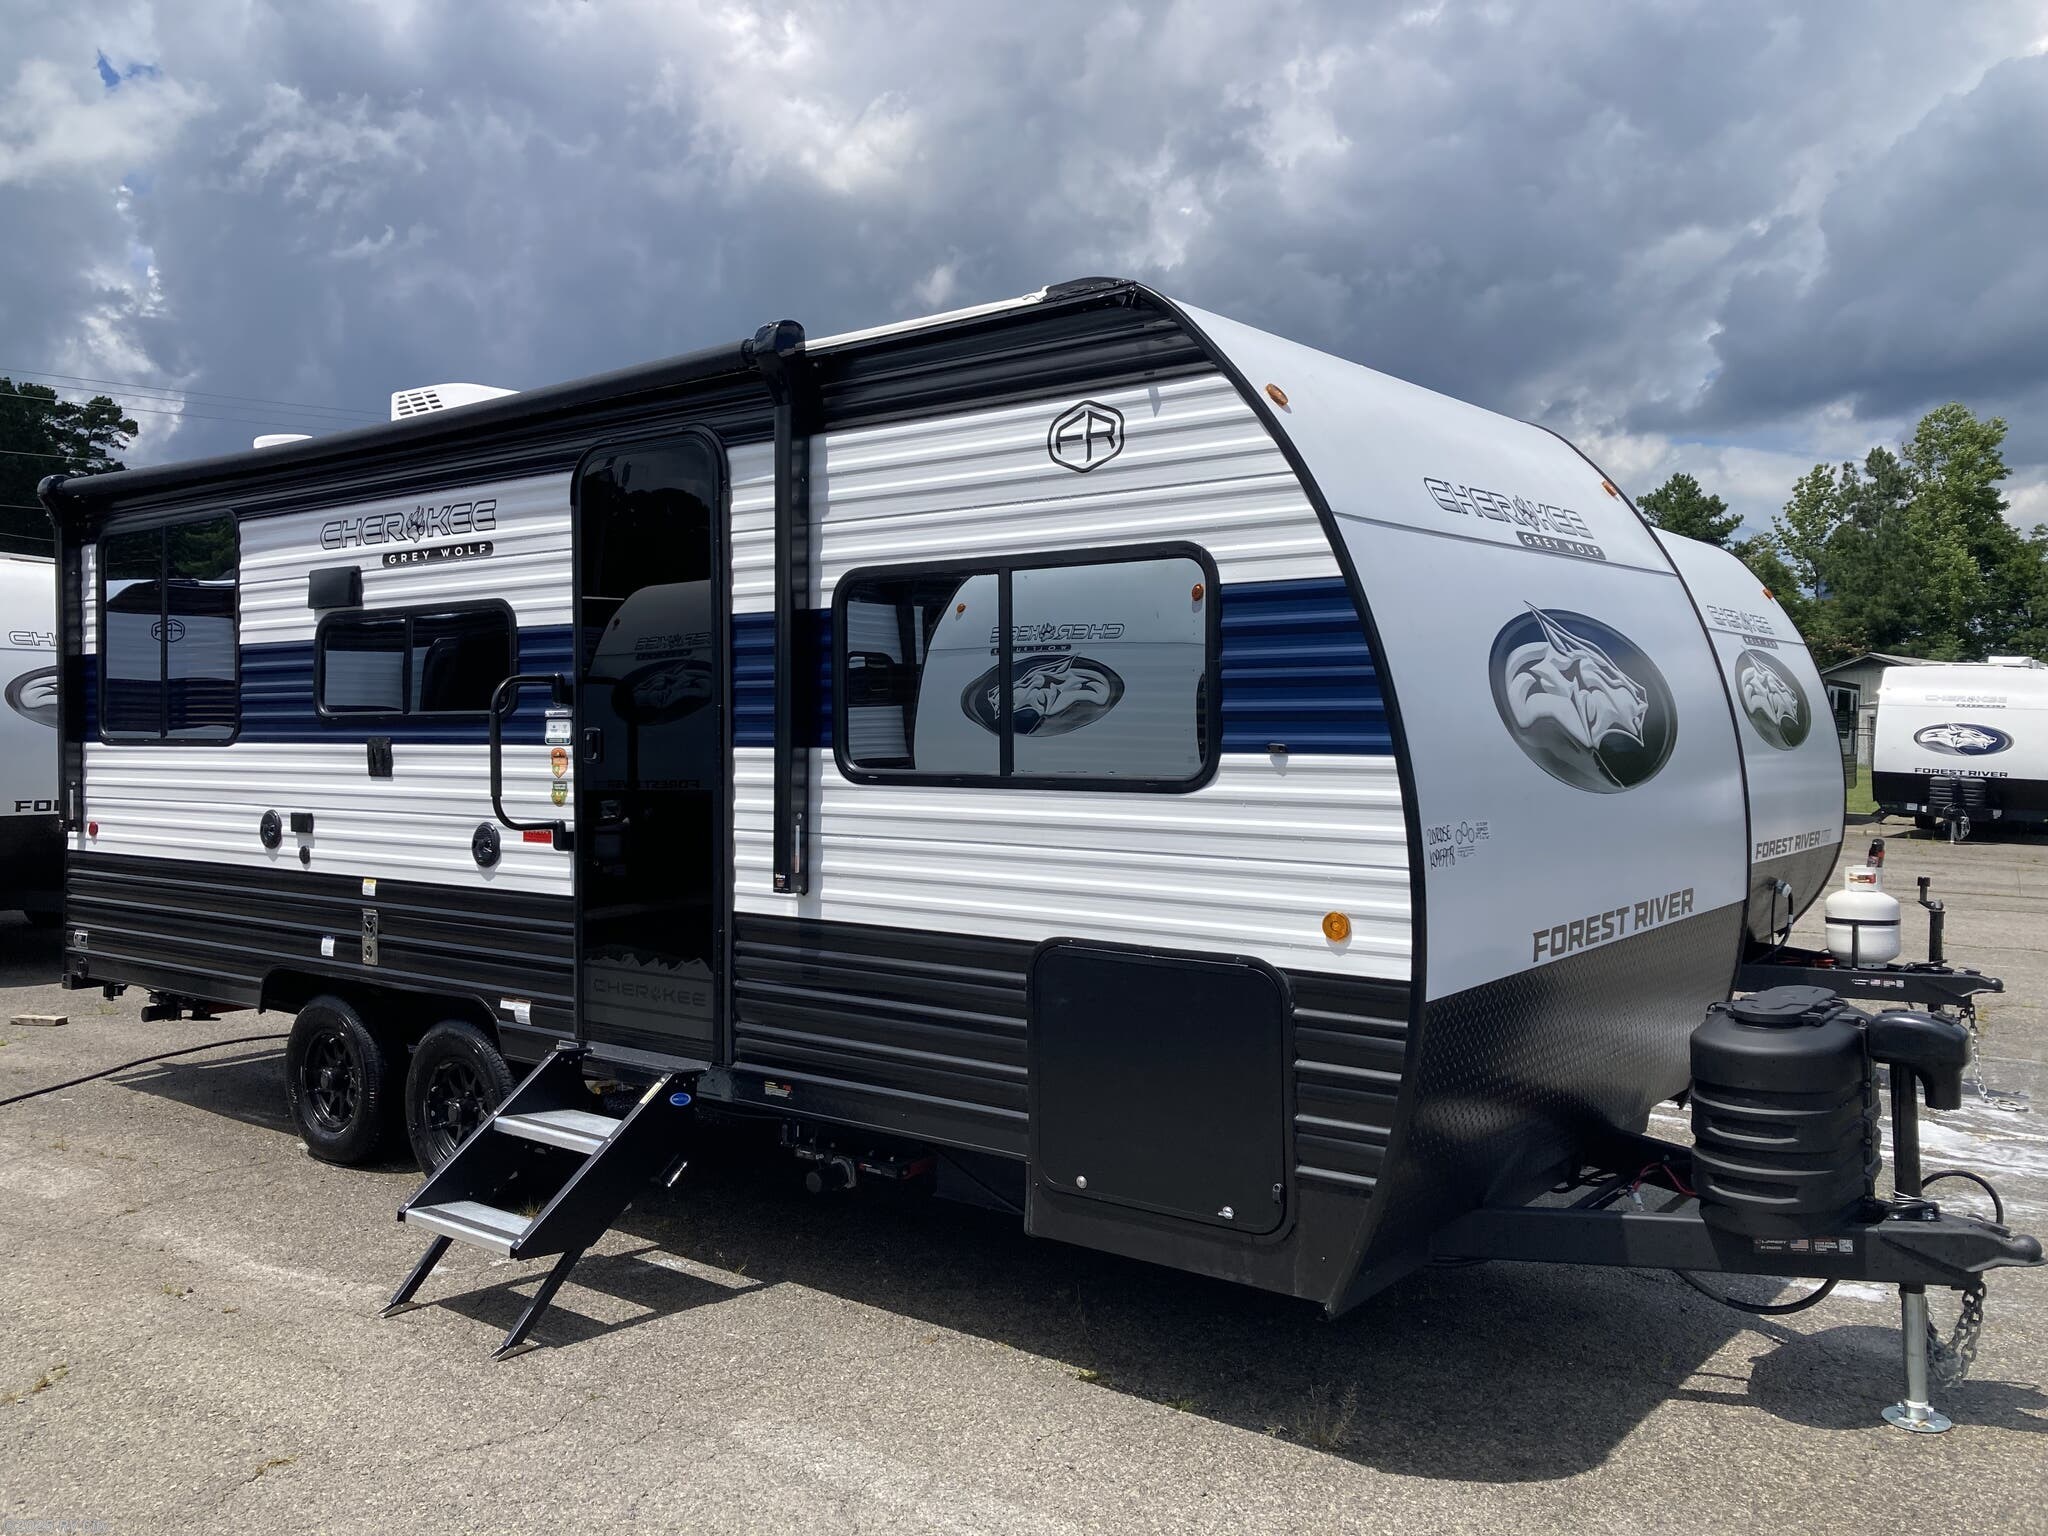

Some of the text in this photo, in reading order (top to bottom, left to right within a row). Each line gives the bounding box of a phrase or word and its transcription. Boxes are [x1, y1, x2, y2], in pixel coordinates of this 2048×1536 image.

[388, 544, 487, 565] GREY WOLF
[1523, 534, 1600, 556] GREY WOLF
[8, 630, 57, 646] CH
[1914, 767, 2009, 778] FOREST RIVER
[1755, 830, 1821, 860] FOREST RIVER
[1532, 887, 1694, 963] FOREST RIVER
